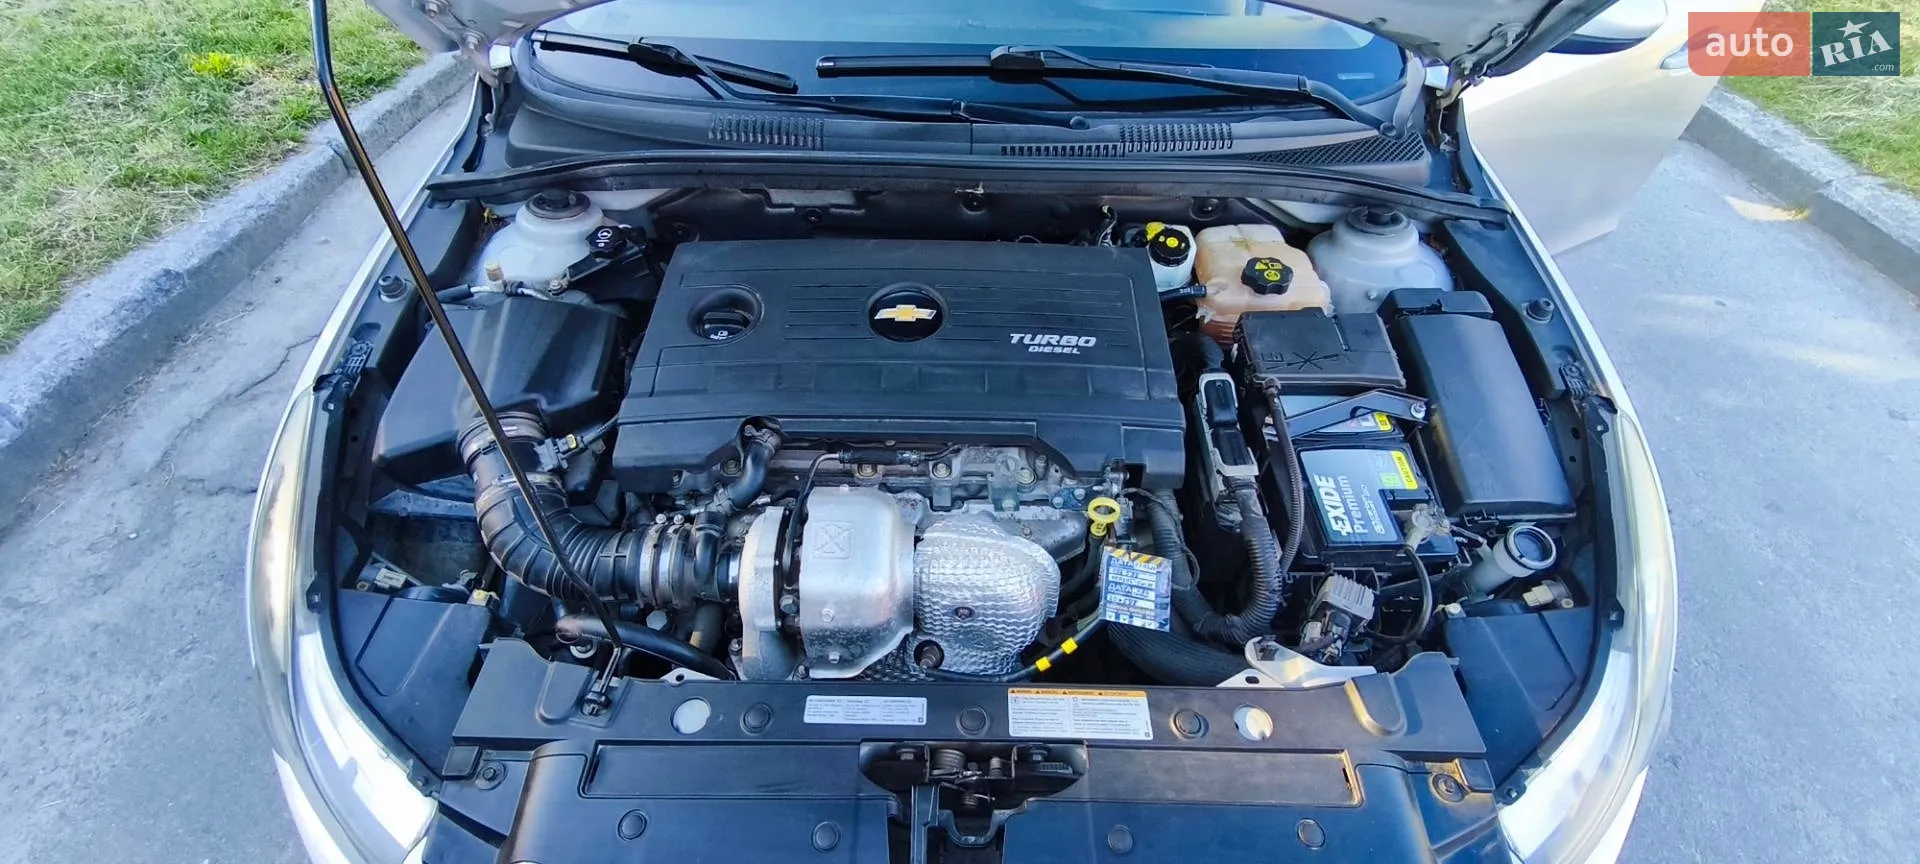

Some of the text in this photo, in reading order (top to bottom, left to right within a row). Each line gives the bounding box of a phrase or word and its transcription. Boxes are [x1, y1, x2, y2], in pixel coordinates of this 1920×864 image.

[1010, 333, 1097, 347] TURBO
[1028, 345, 1081, 354] DIESEL
[1313, 473, 1353, 536] EXIDE
[1338, 475, 1369, 534] Premium
